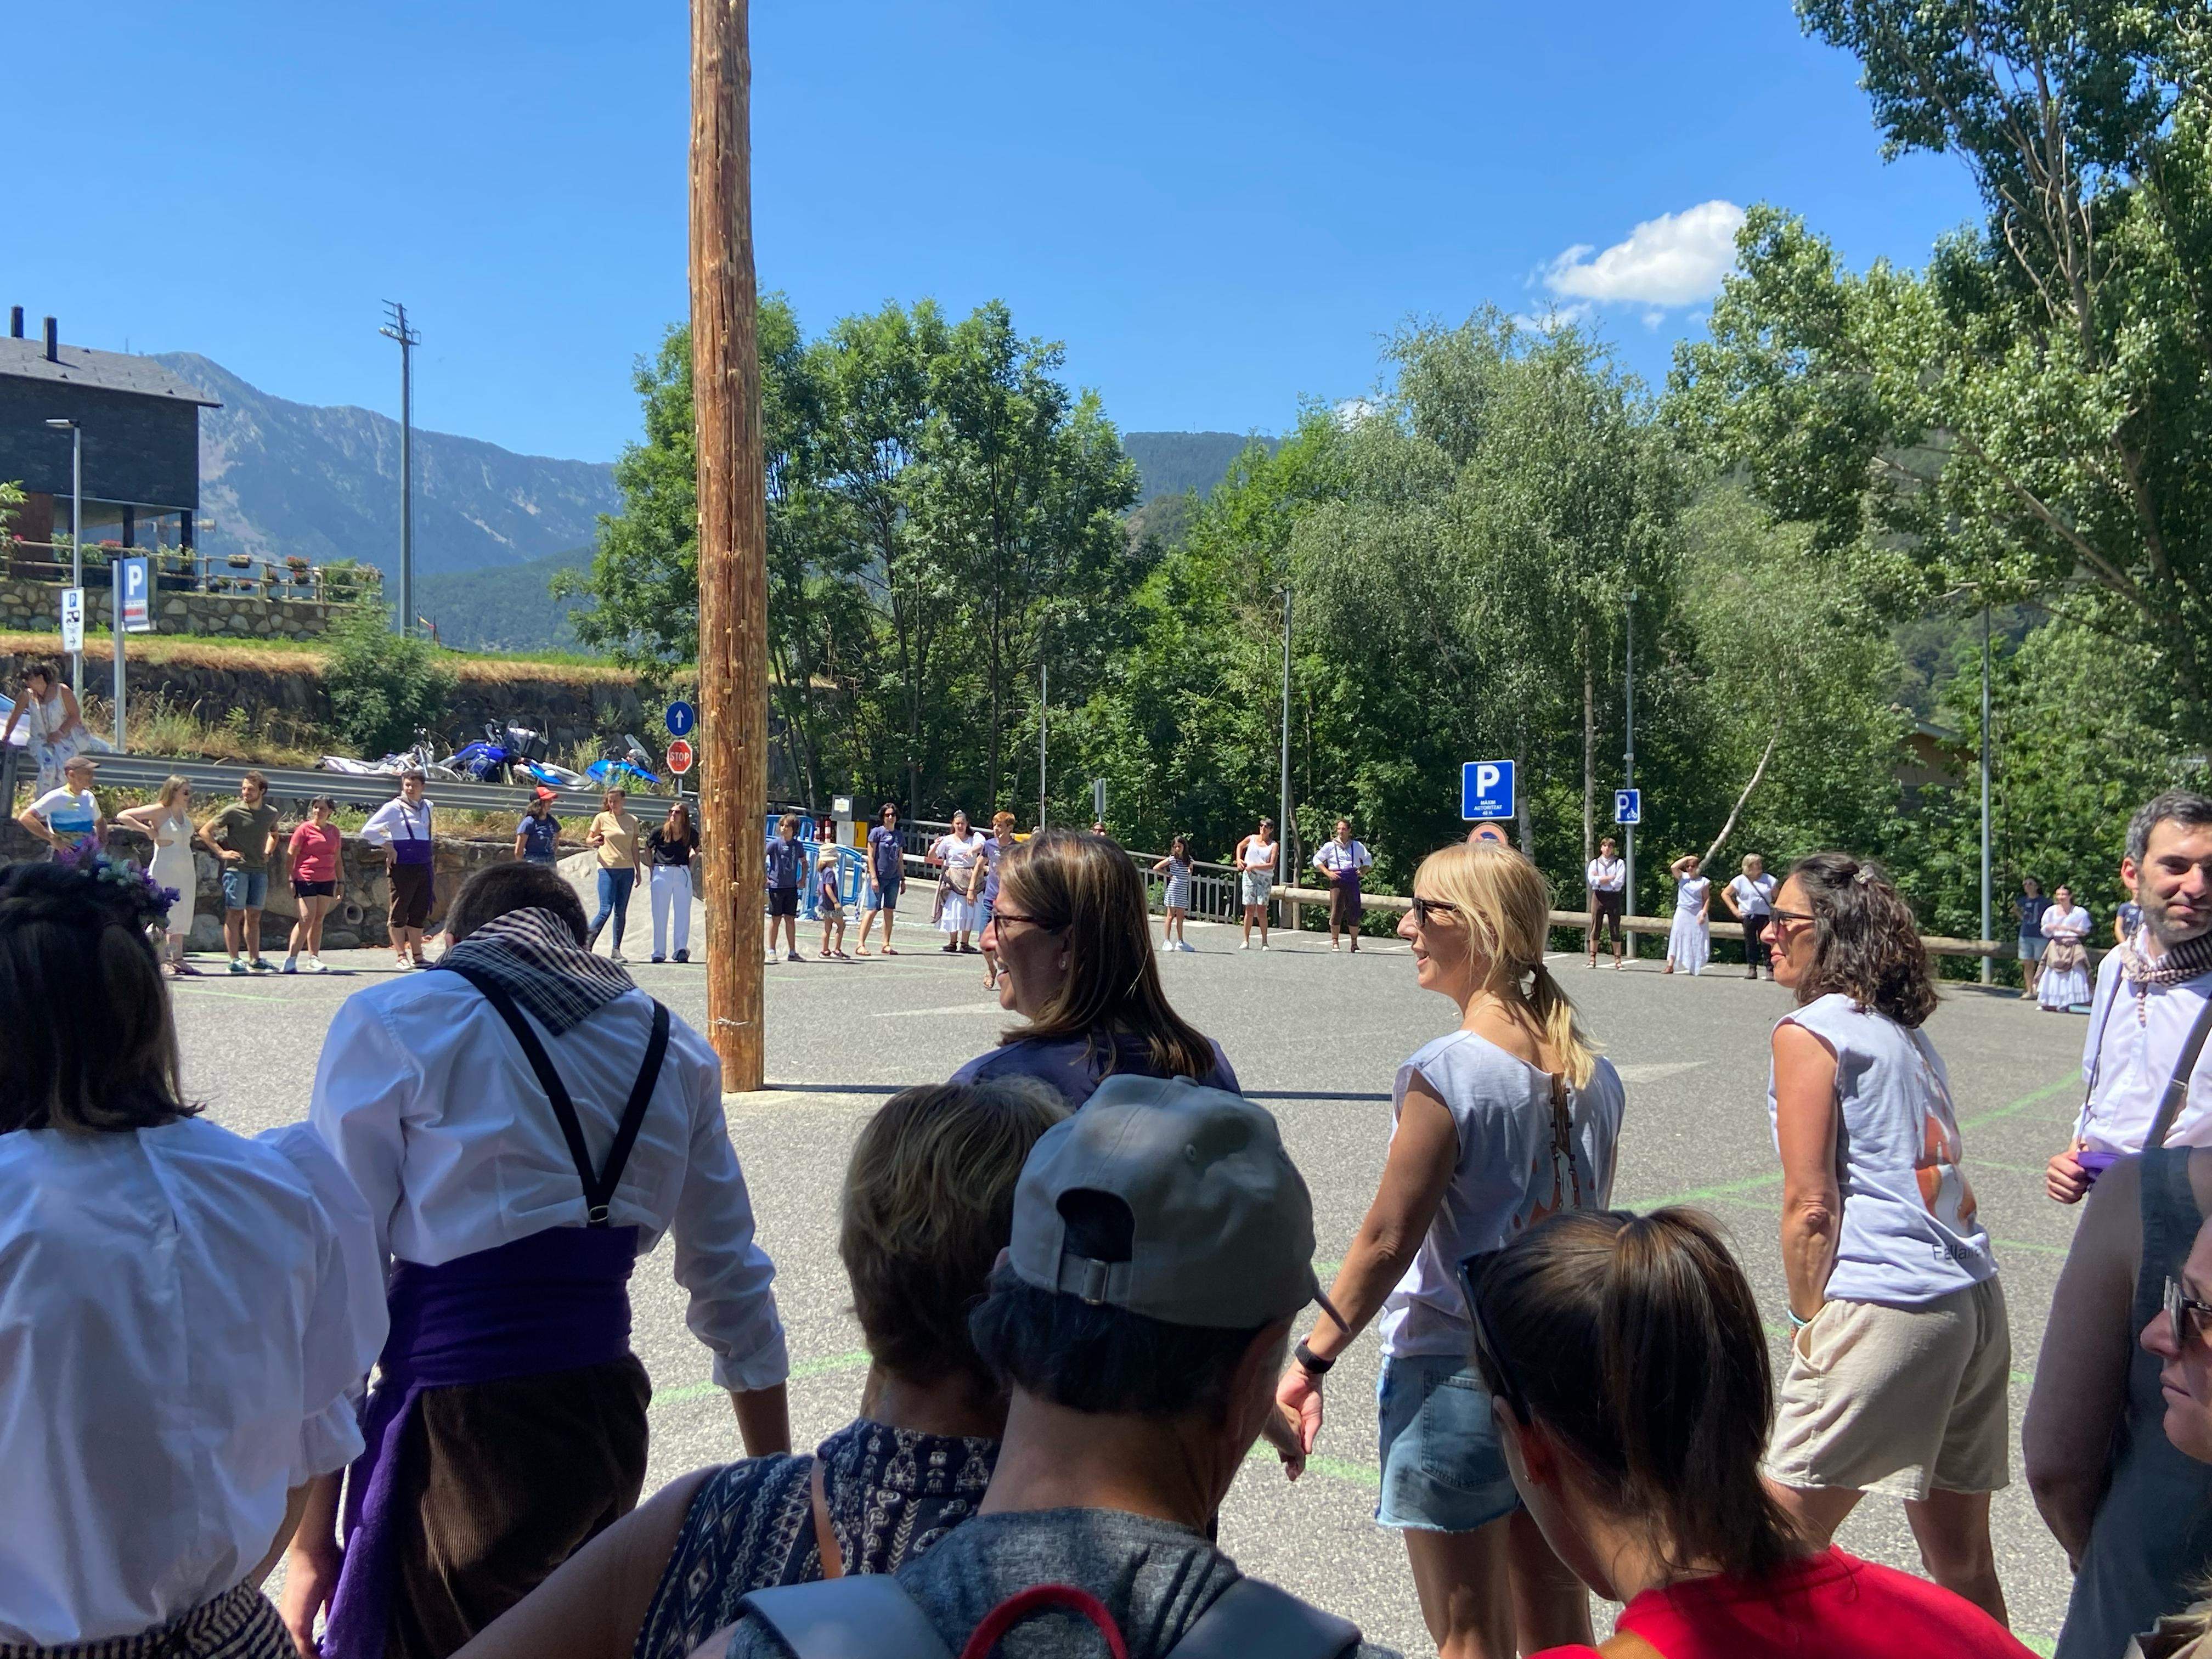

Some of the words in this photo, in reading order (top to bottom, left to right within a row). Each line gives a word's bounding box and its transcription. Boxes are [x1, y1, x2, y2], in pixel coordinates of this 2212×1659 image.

[128, 565, 143, 596] P
[670, 752, 690, 762] STOP
[1476, 765, 1500, 797] P
[1617, 794, 1629, 819] P
